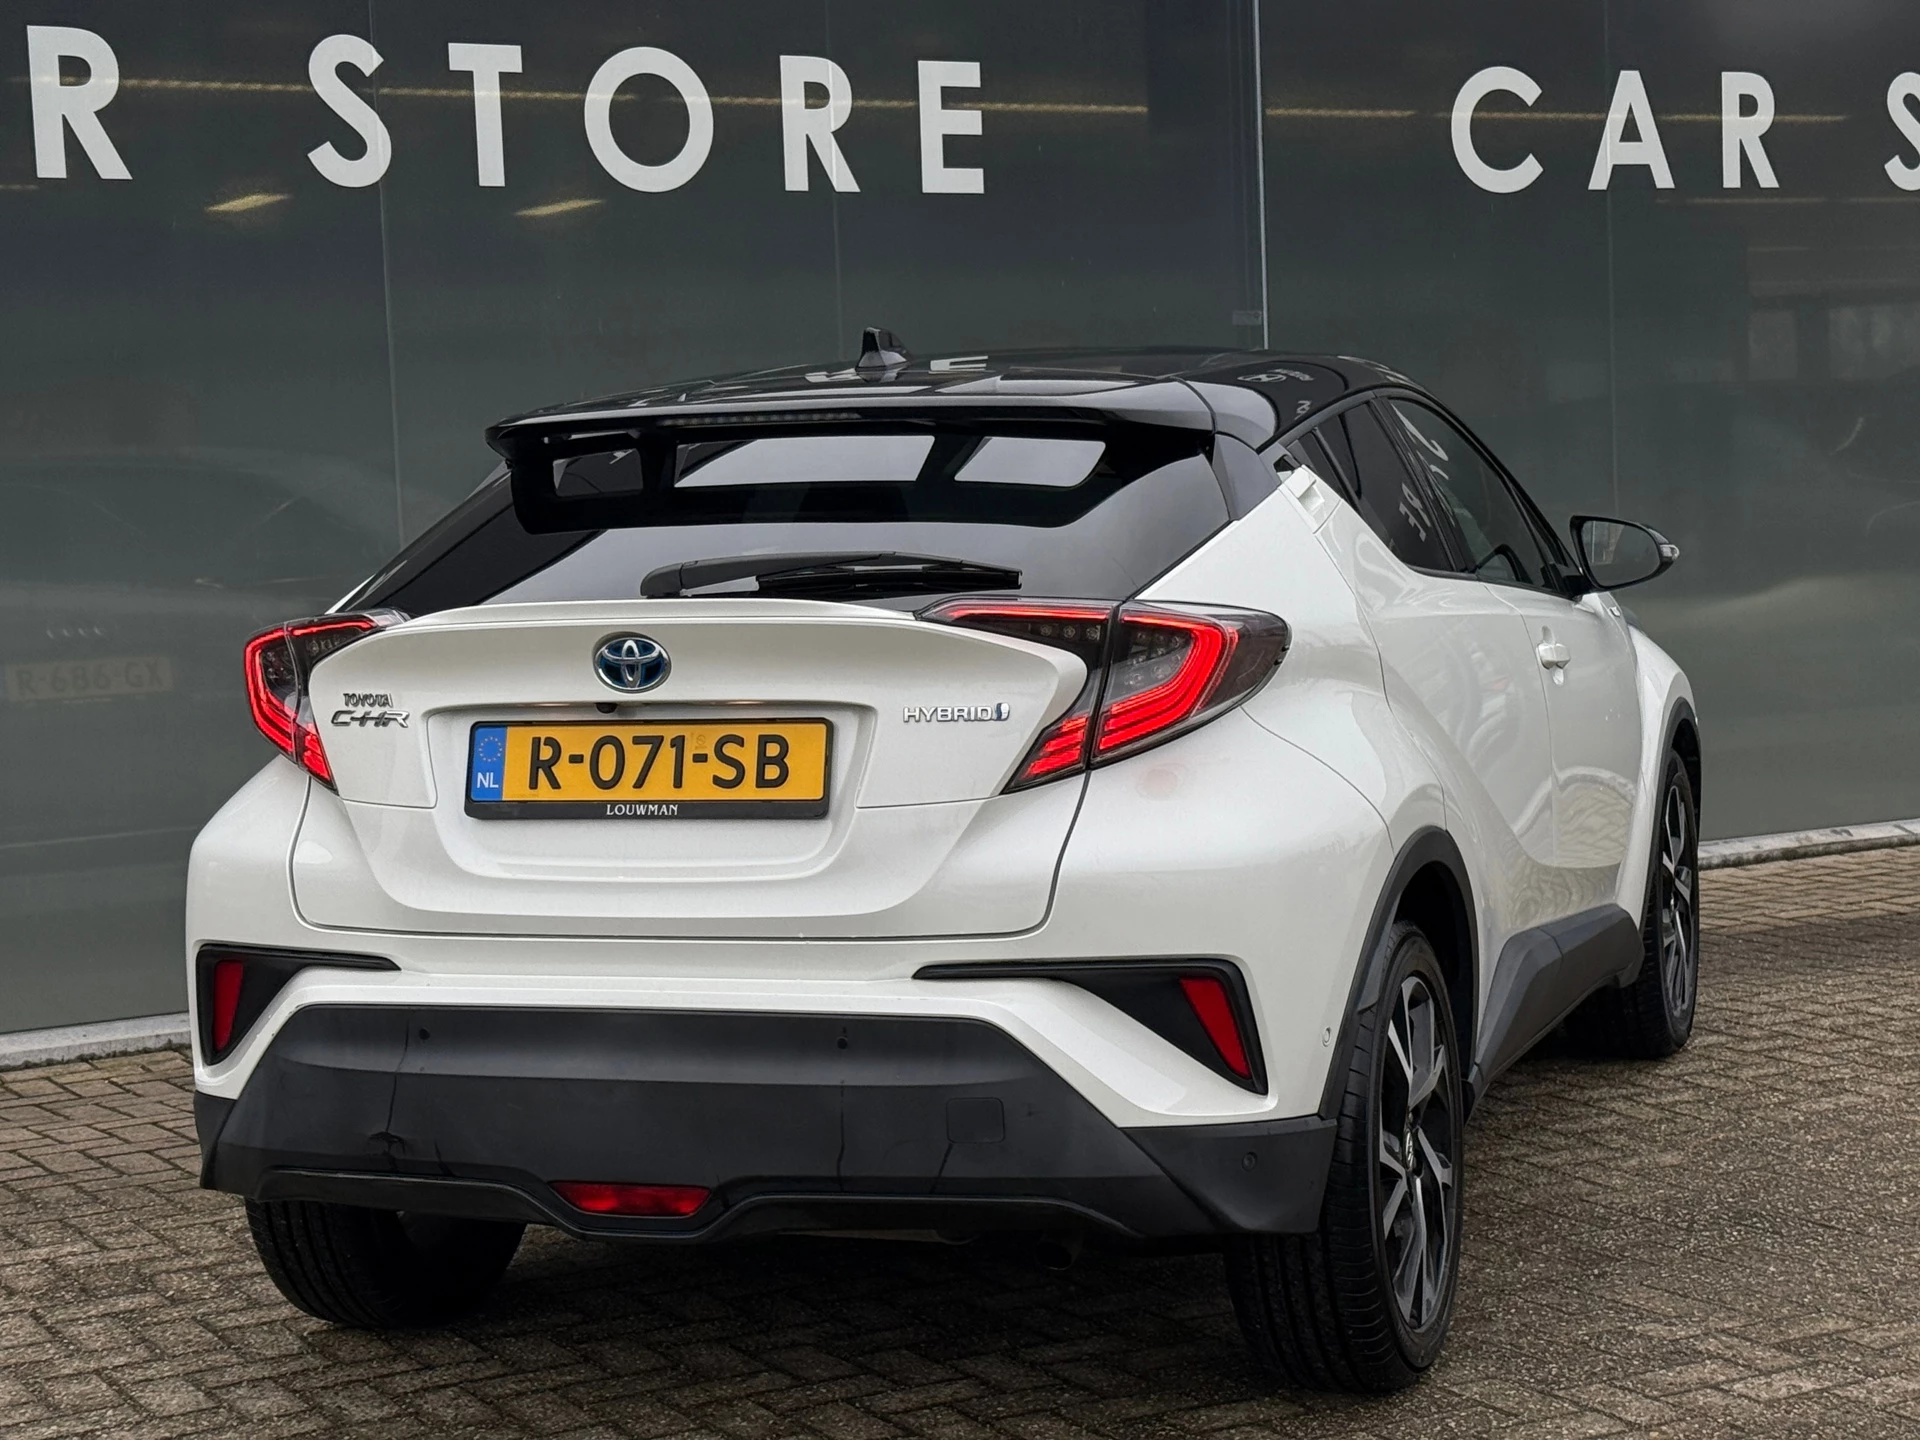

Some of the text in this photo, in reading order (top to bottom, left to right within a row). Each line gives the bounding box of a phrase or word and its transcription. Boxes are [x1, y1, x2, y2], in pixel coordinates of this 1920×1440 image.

[26, 25, 985, 193] R STORE
[1451, 67, 1780, 193] CAR
[343, 693, 393, 708] TOYOTA
[903, 706, 993, 722] HYBRID
[476, 734, 790, 790] NL R-071-SB
[605, 803, 679, 816] LOUWMAN
